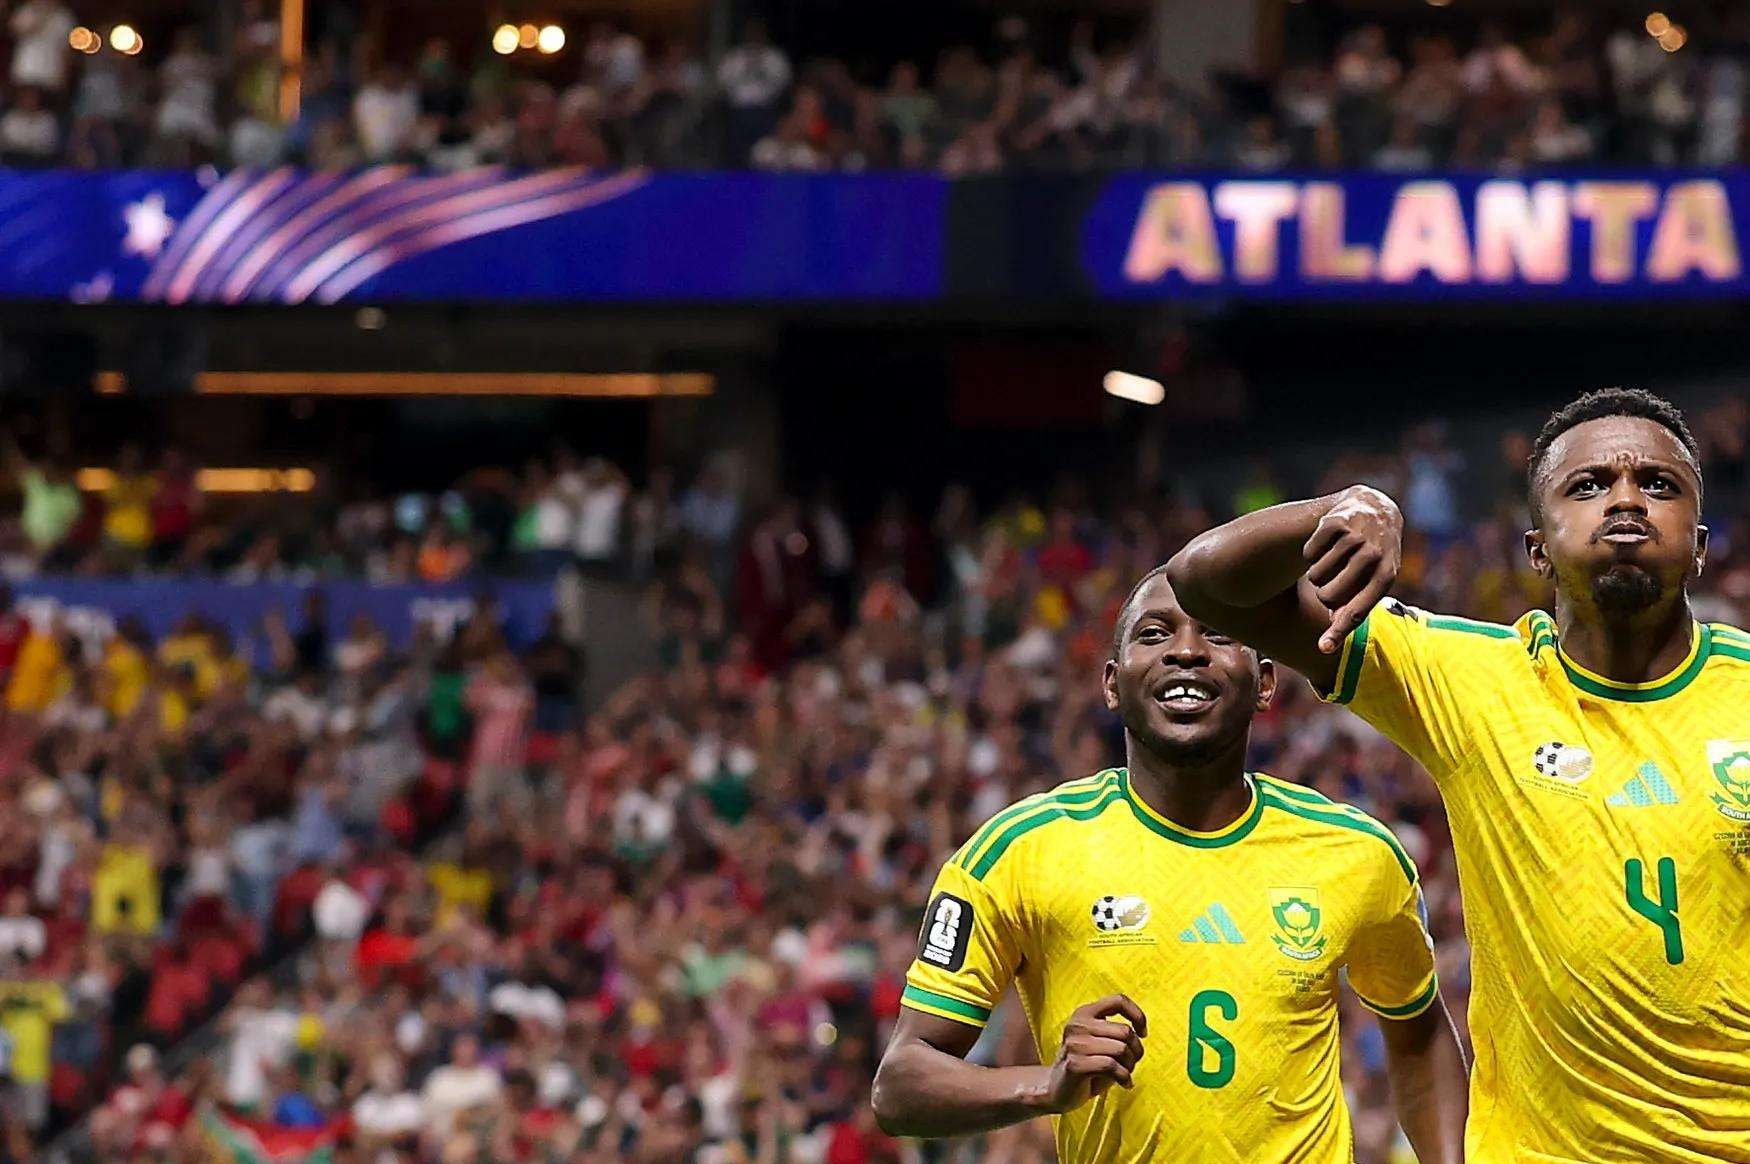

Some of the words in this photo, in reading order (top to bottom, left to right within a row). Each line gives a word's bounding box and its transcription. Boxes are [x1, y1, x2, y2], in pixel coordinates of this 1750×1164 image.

[1122, 179, 1742, 285] ATLANTA
[1720, 805, 1746, 819] SOUTH
[1624, 856, 1685, 966] 4
[1186, 989, 1239, 1089] 6
